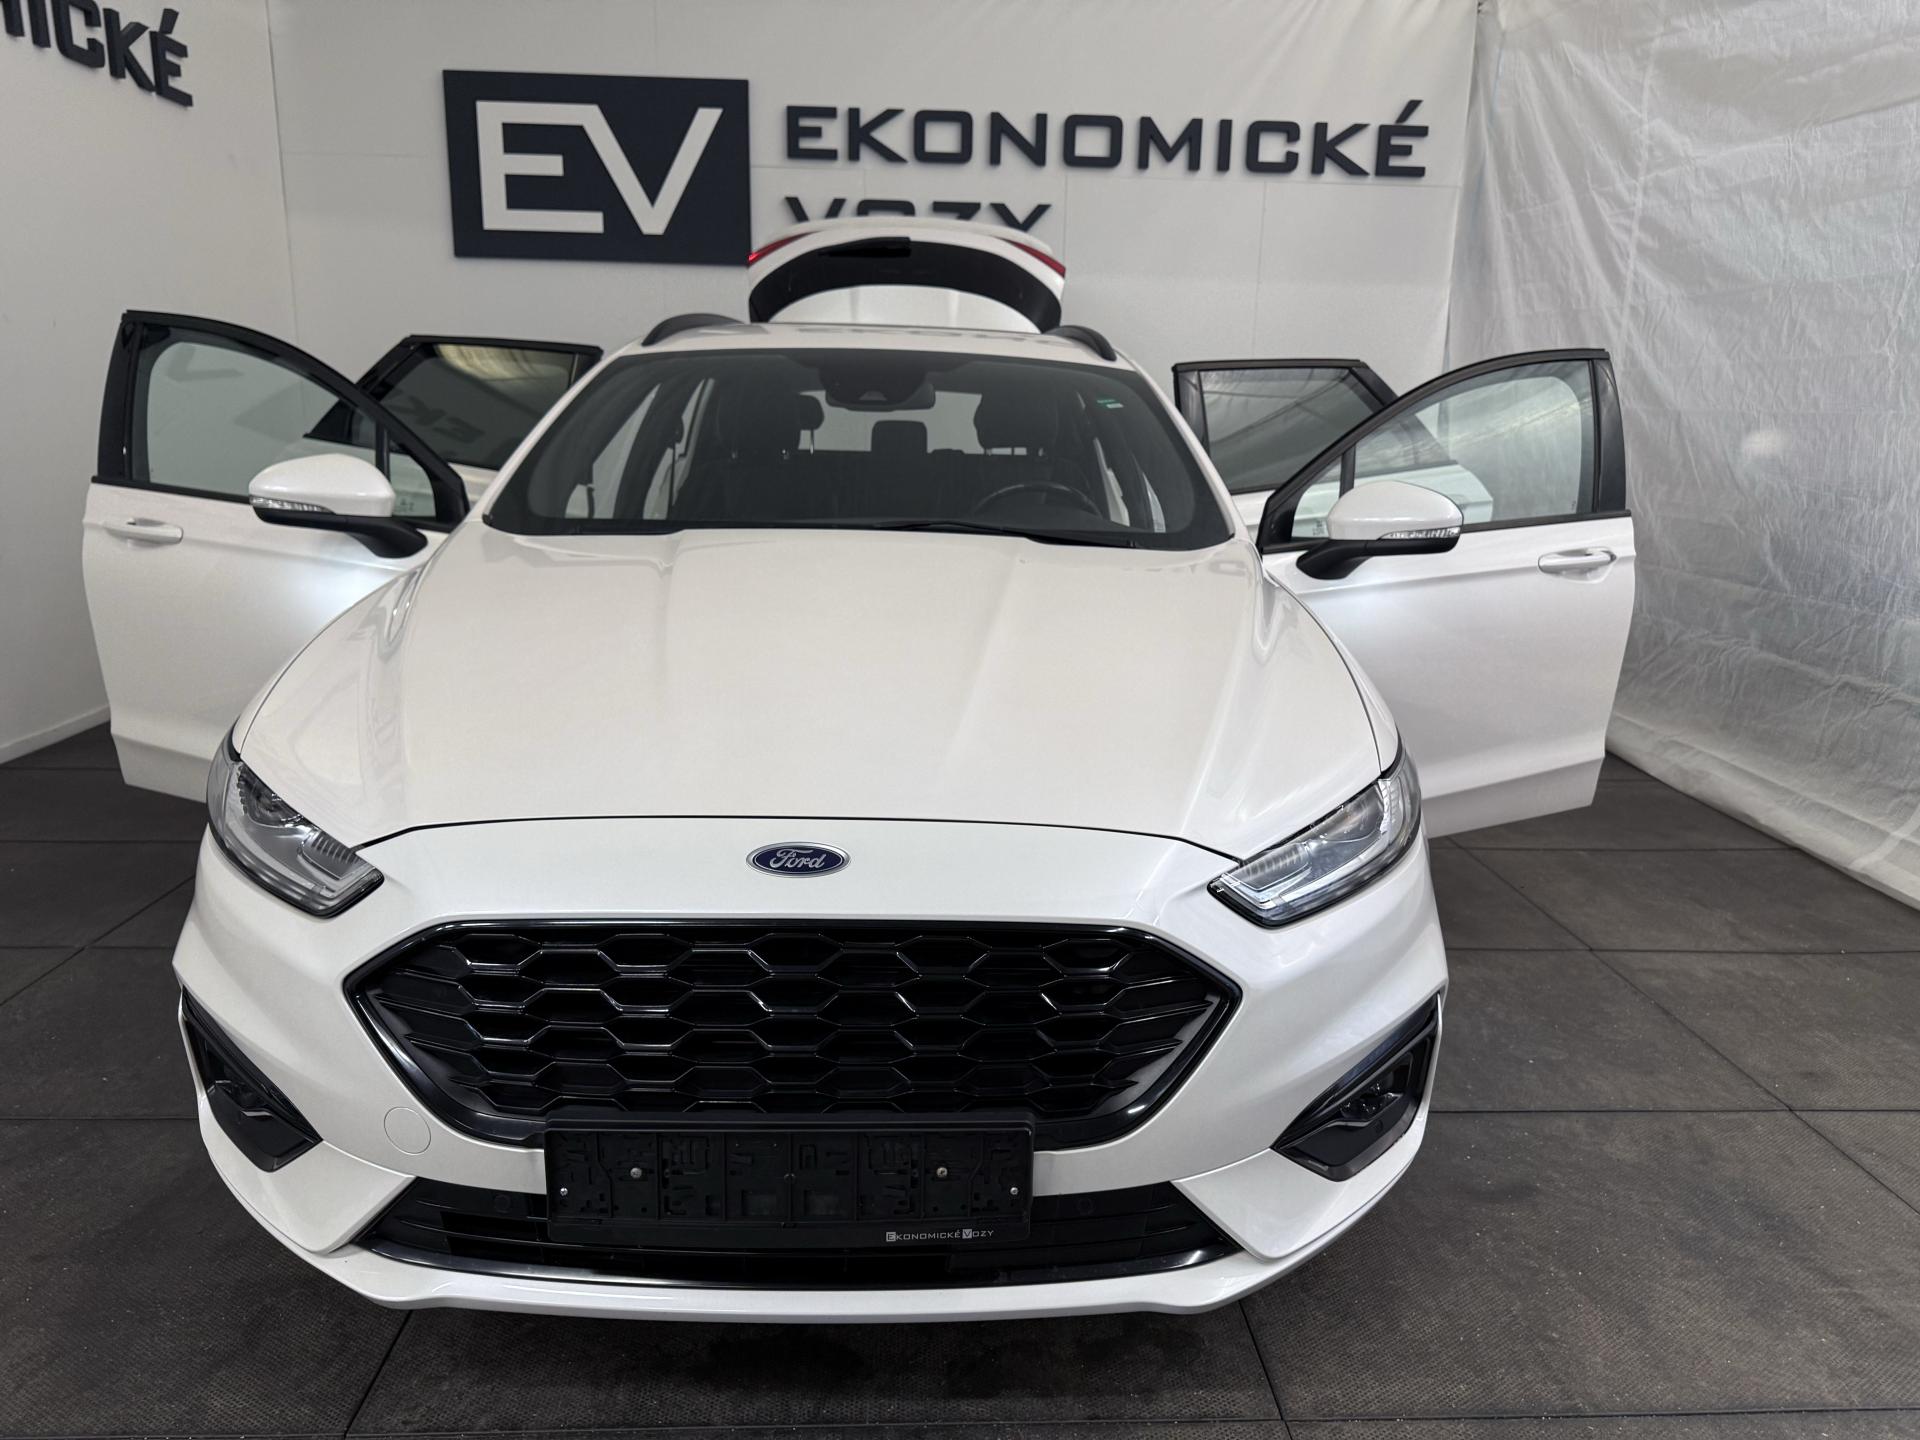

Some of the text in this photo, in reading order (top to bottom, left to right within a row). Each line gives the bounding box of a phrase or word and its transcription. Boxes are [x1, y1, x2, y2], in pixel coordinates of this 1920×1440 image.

[786, 99, 1429, 179] EKONOMICKÉ
[476, 100, 723, 236] EV
[769, 848, 826, 868] Ford
[886, 1229, 994, 1242] EKONOMICKÉ VOZY
